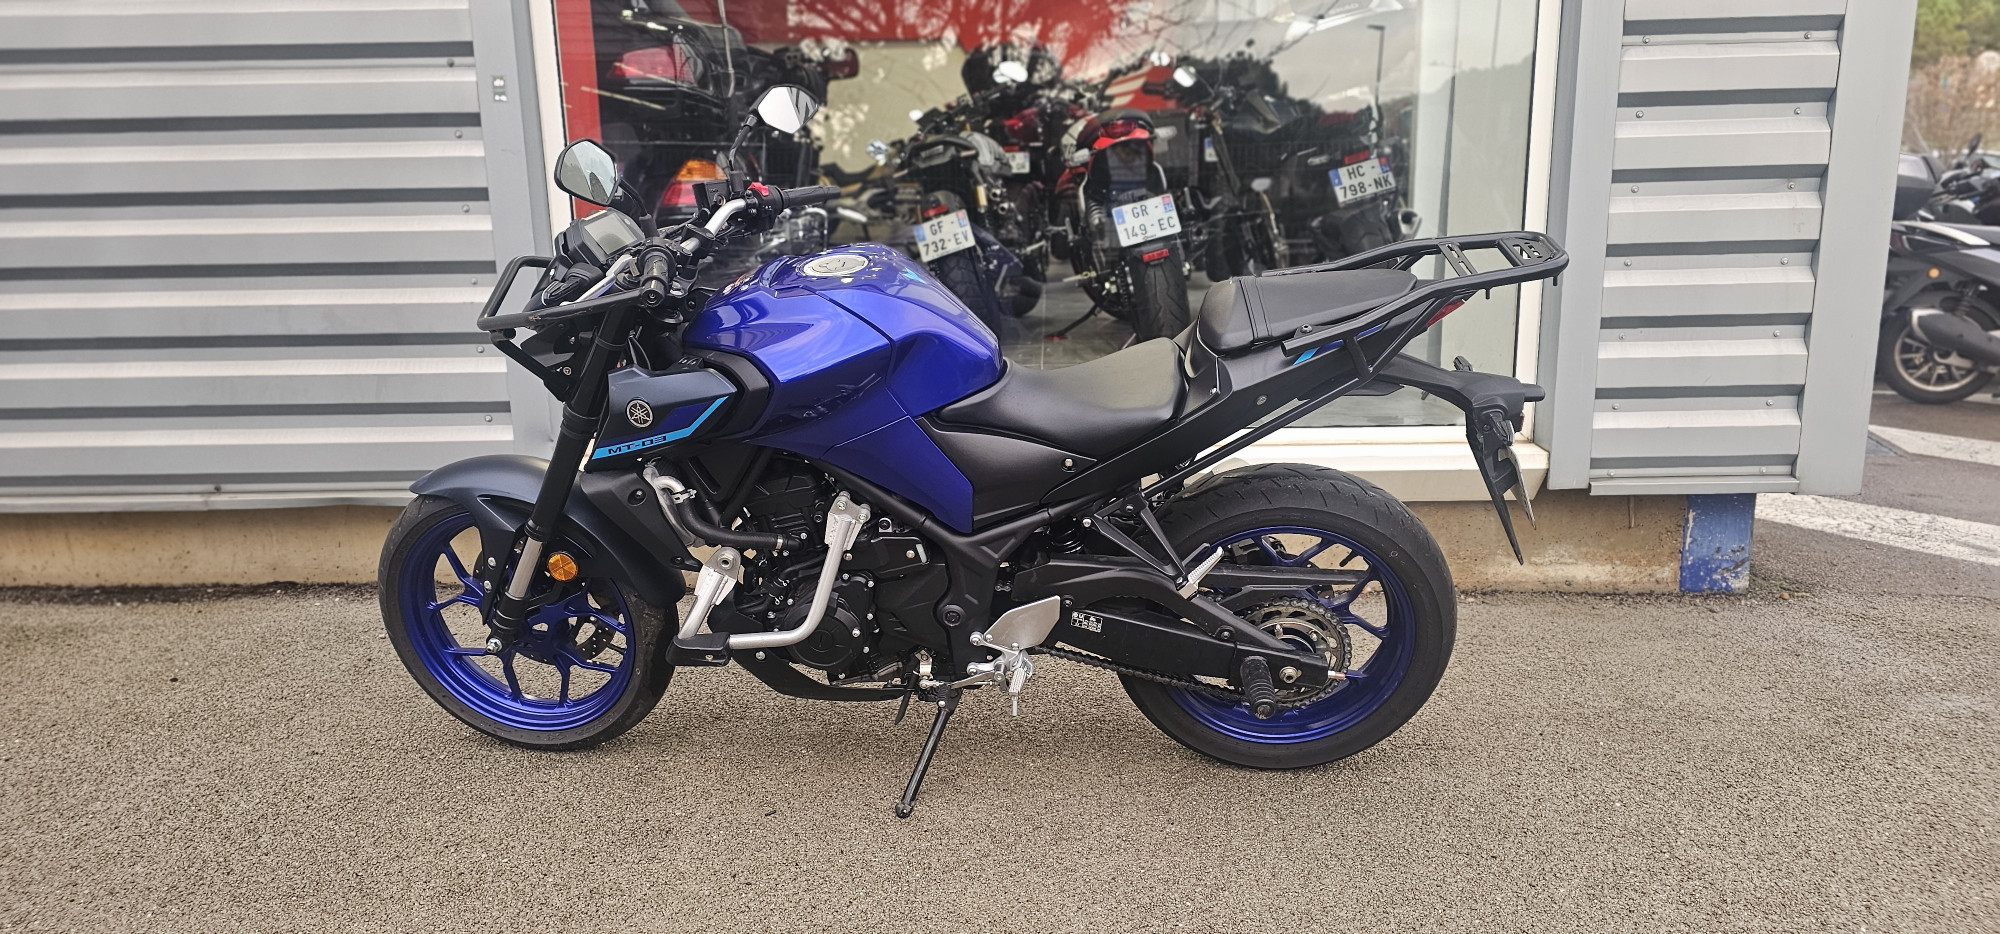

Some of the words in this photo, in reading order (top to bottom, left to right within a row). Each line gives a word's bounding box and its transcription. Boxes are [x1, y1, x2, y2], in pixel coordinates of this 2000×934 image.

[1346, 164, 1366, 180] HC
[1339, 174, 1393, 199] 798-NK
[1131, 204, 1149, 219] GR
[929, 220, 944, 236] GF
[1123, 216, 1176, 240] 149-EC
[922, 229, 969, 256] 732-EV
[608, 435, 667, 455] MT-03
